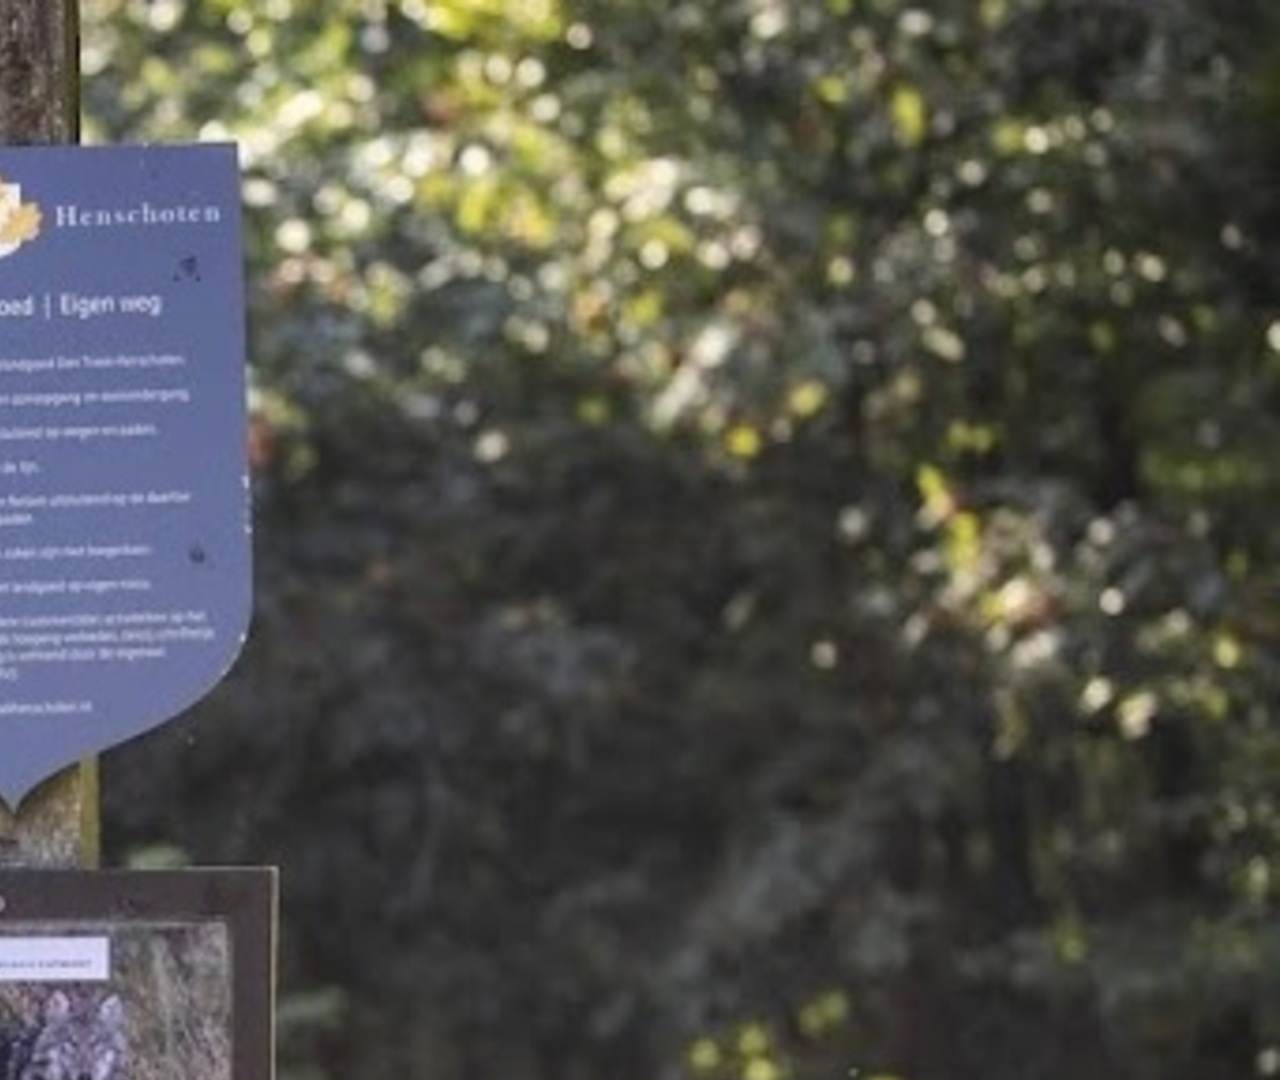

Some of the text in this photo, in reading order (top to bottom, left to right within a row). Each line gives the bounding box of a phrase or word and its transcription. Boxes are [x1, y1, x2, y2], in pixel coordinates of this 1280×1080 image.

[56, 202, 220, 227] Henschoten
[59, 293, 115, 320] Eigen
[119, 294, 163, 317] weg
